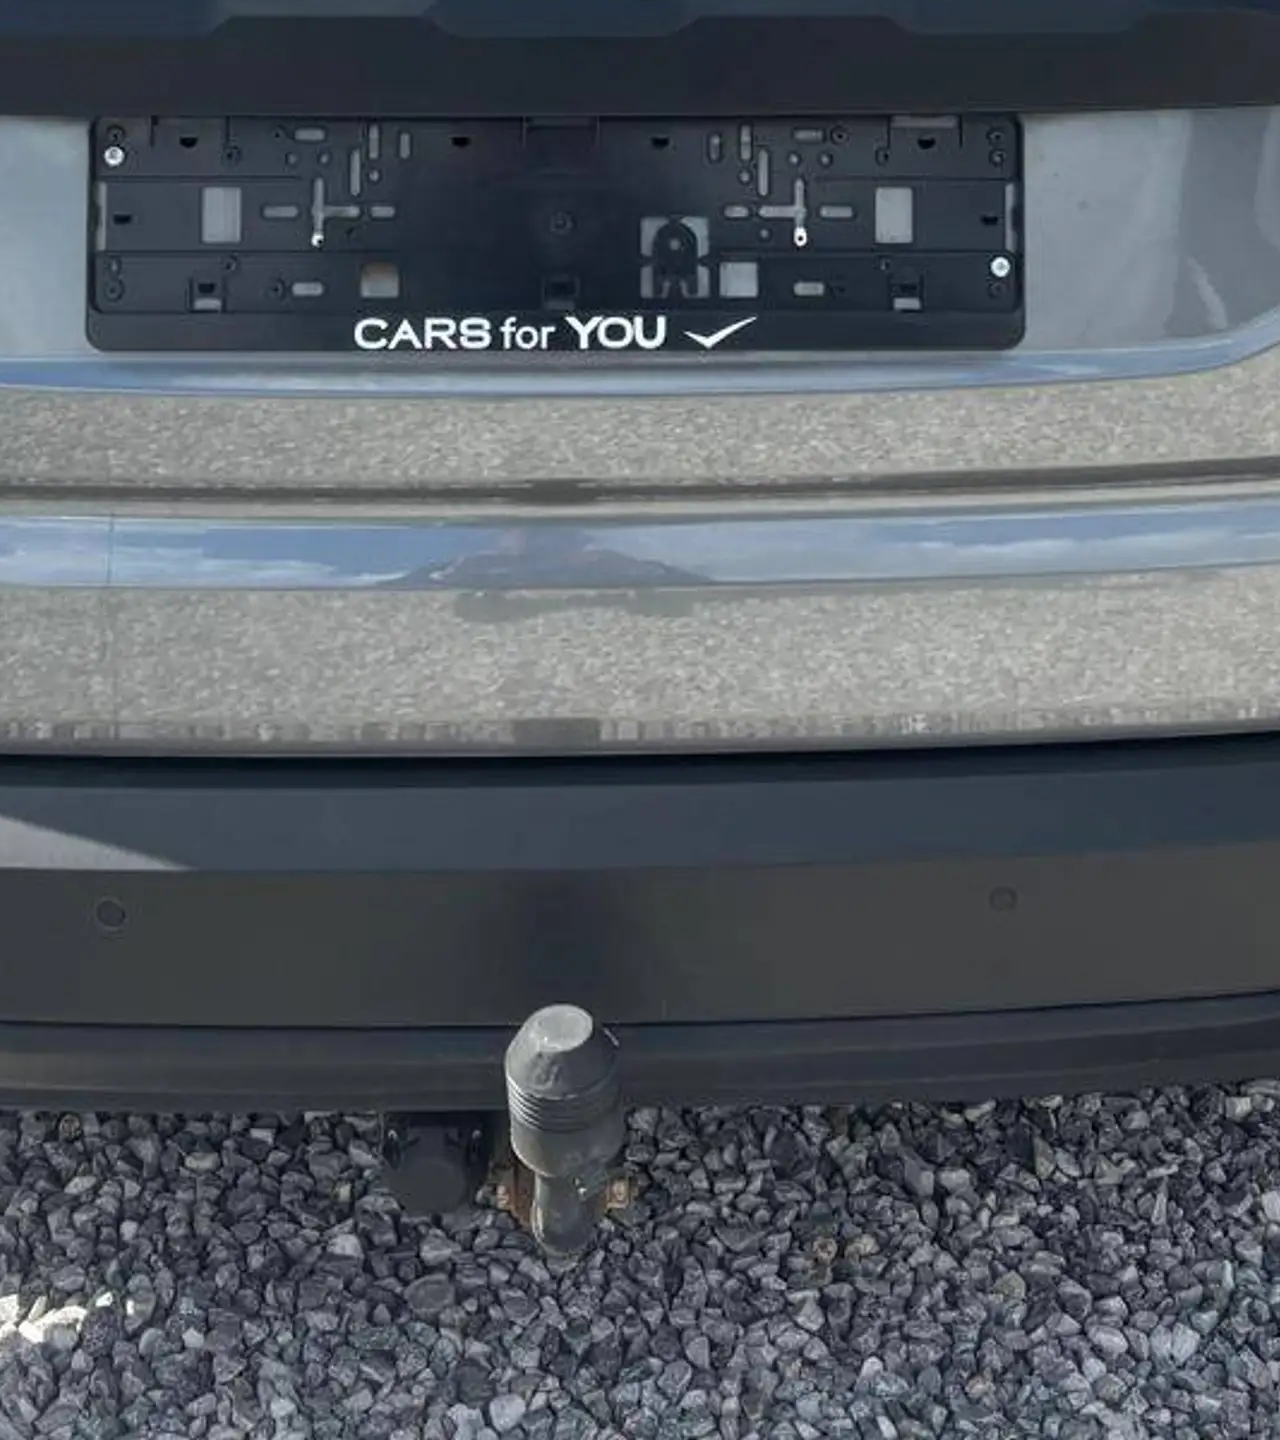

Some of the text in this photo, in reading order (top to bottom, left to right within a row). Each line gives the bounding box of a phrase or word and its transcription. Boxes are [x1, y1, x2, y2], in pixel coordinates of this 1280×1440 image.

[354, 317, 667, 350] CARS for YOU
